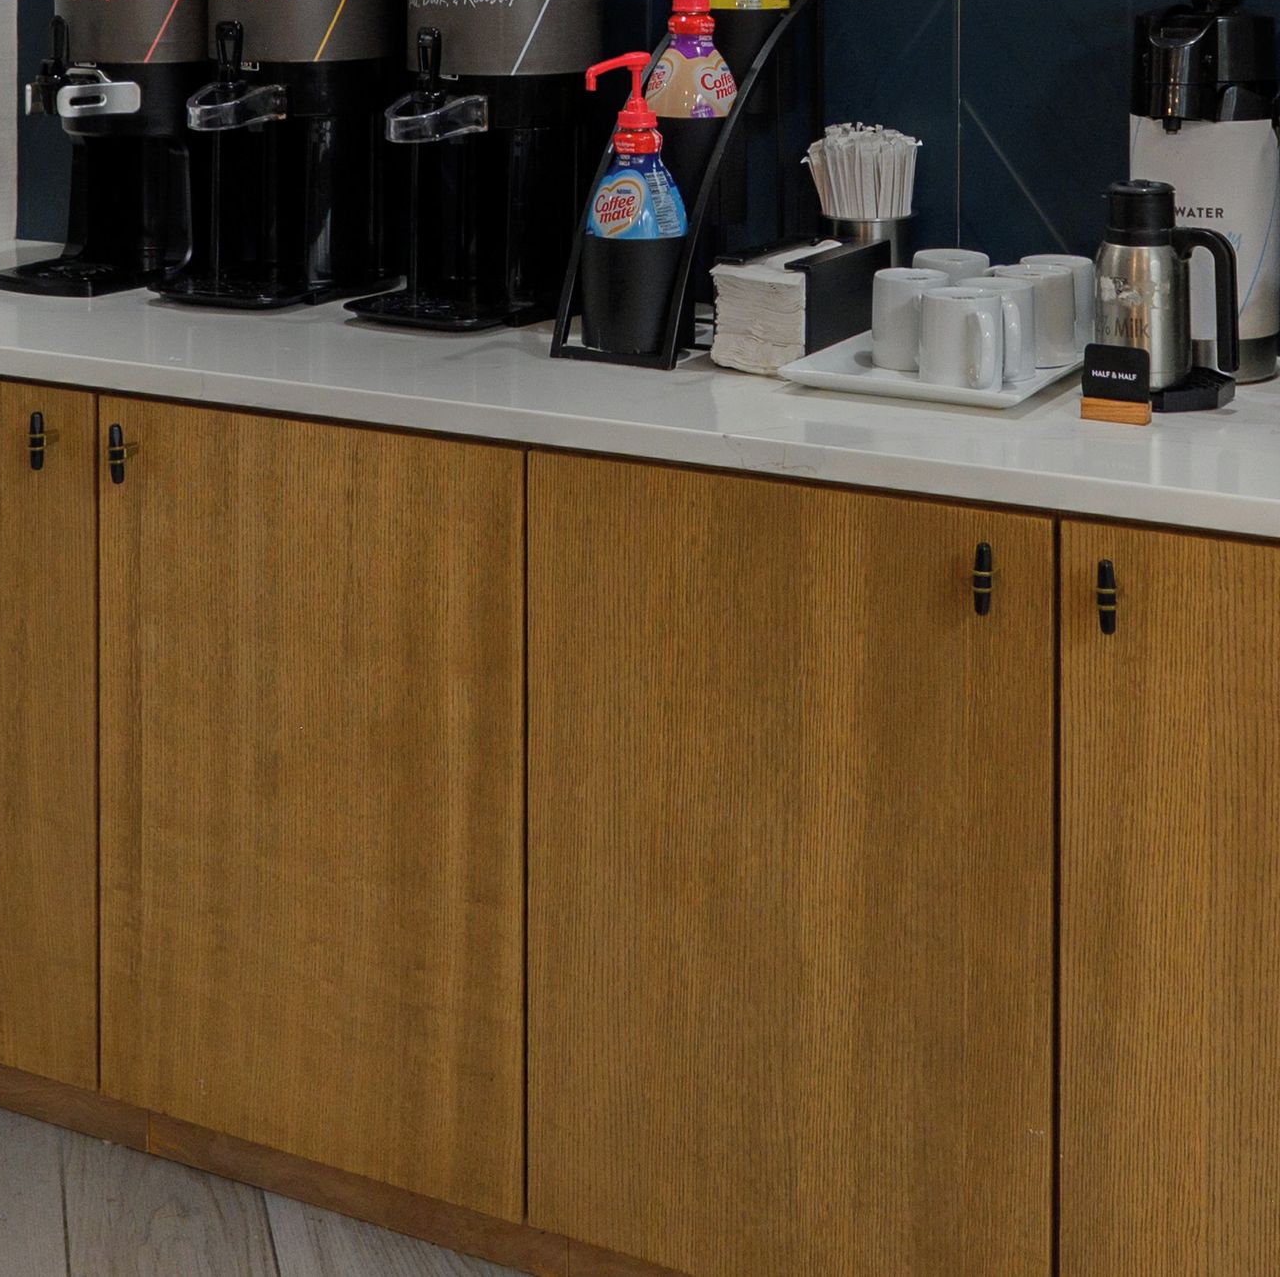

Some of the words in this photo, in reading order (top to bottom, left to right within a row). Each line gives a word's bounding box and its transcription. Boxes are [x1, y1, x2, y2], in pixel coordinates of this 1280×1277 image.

[701, 73, 733, 90] Coffe
[595, 194, 635, 213] Coffee
[600, 207, 634, 223] mate
[1174, 207, 1224, 219] WATER
[1114, 318, 1150, 338] Milk
